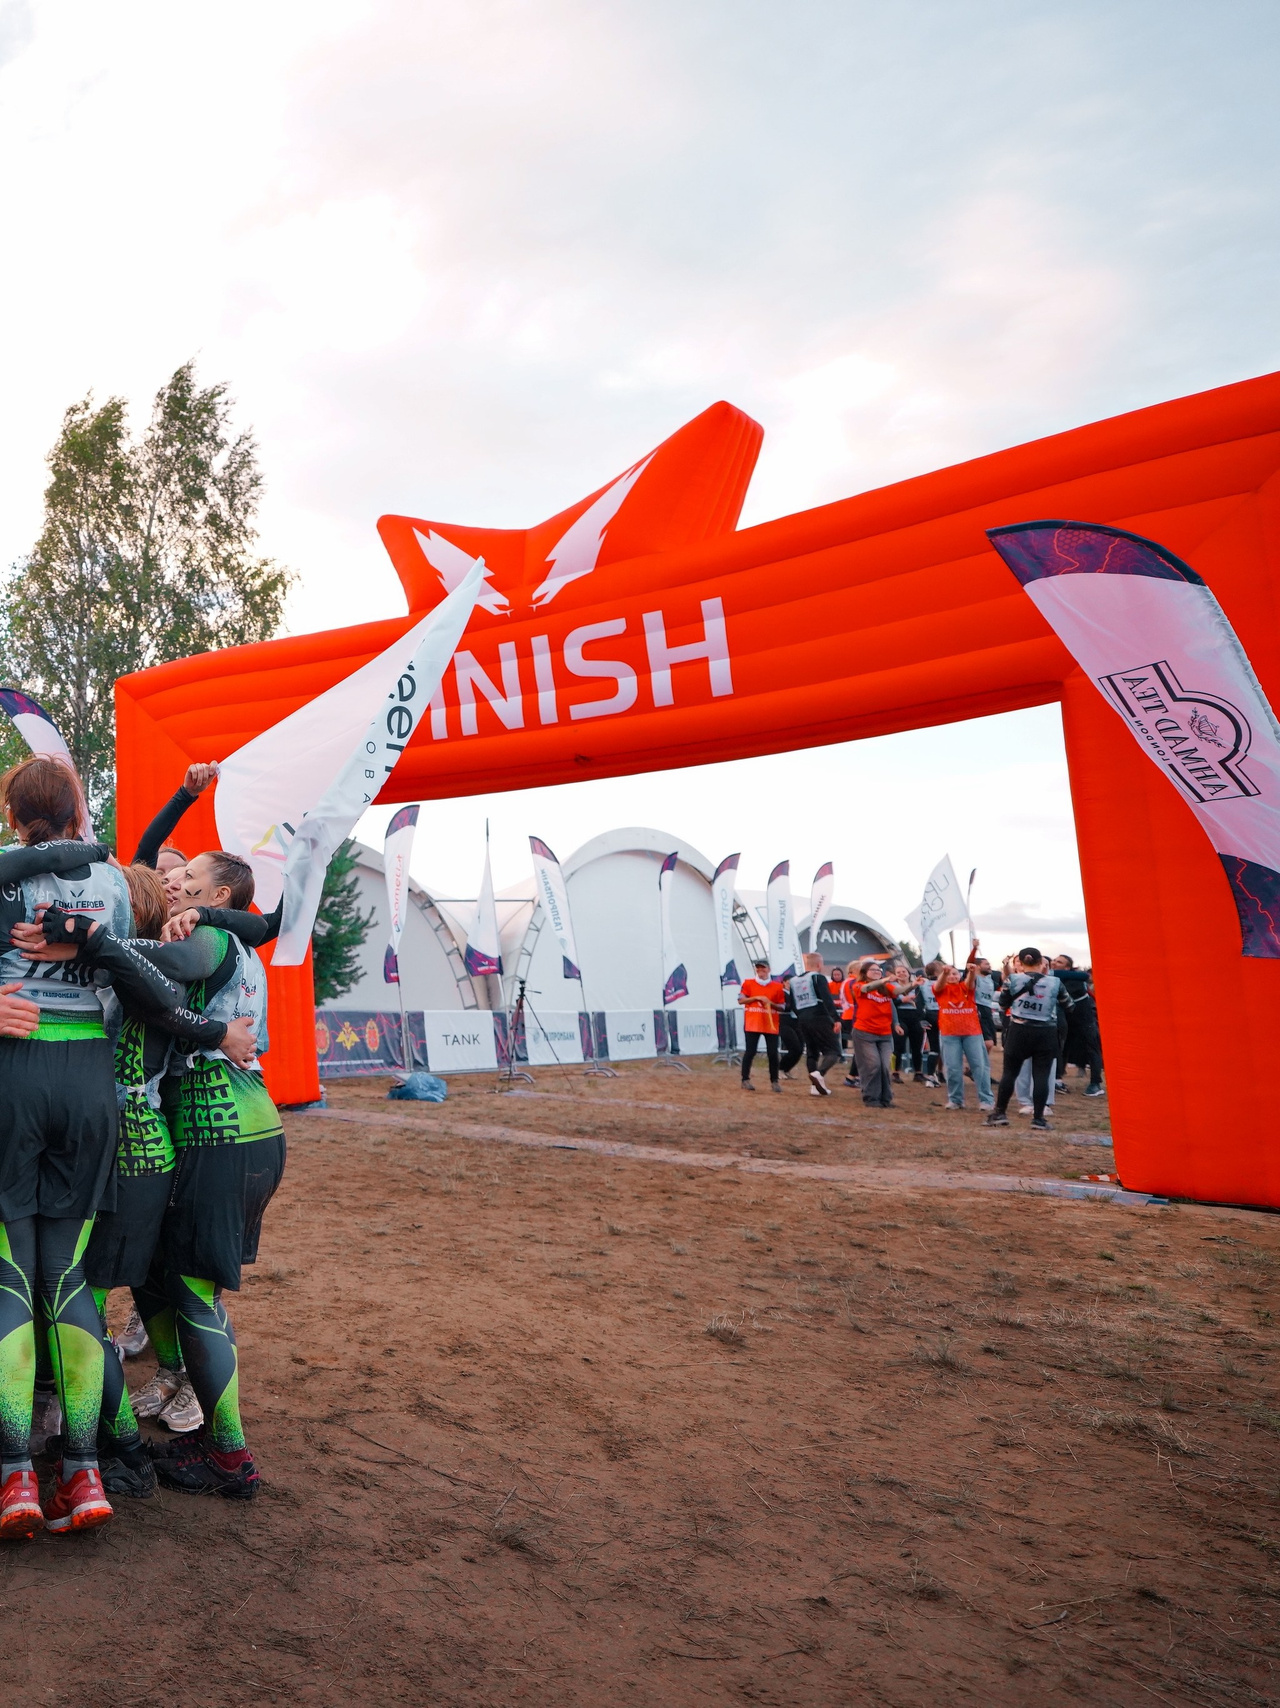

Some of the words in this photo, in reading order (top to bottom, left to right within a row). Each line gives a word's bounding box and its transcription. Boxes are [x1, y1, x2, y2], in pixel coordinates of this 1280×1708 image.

[429, 597, 734, 741] INISH
[75, 899, 105, 909] ГЕРОЕВ
[818, 928, 858, 945] ANK
[1017, 999, 1044, 1012] 7841
[441, 1033, 481, 1046] TANK
